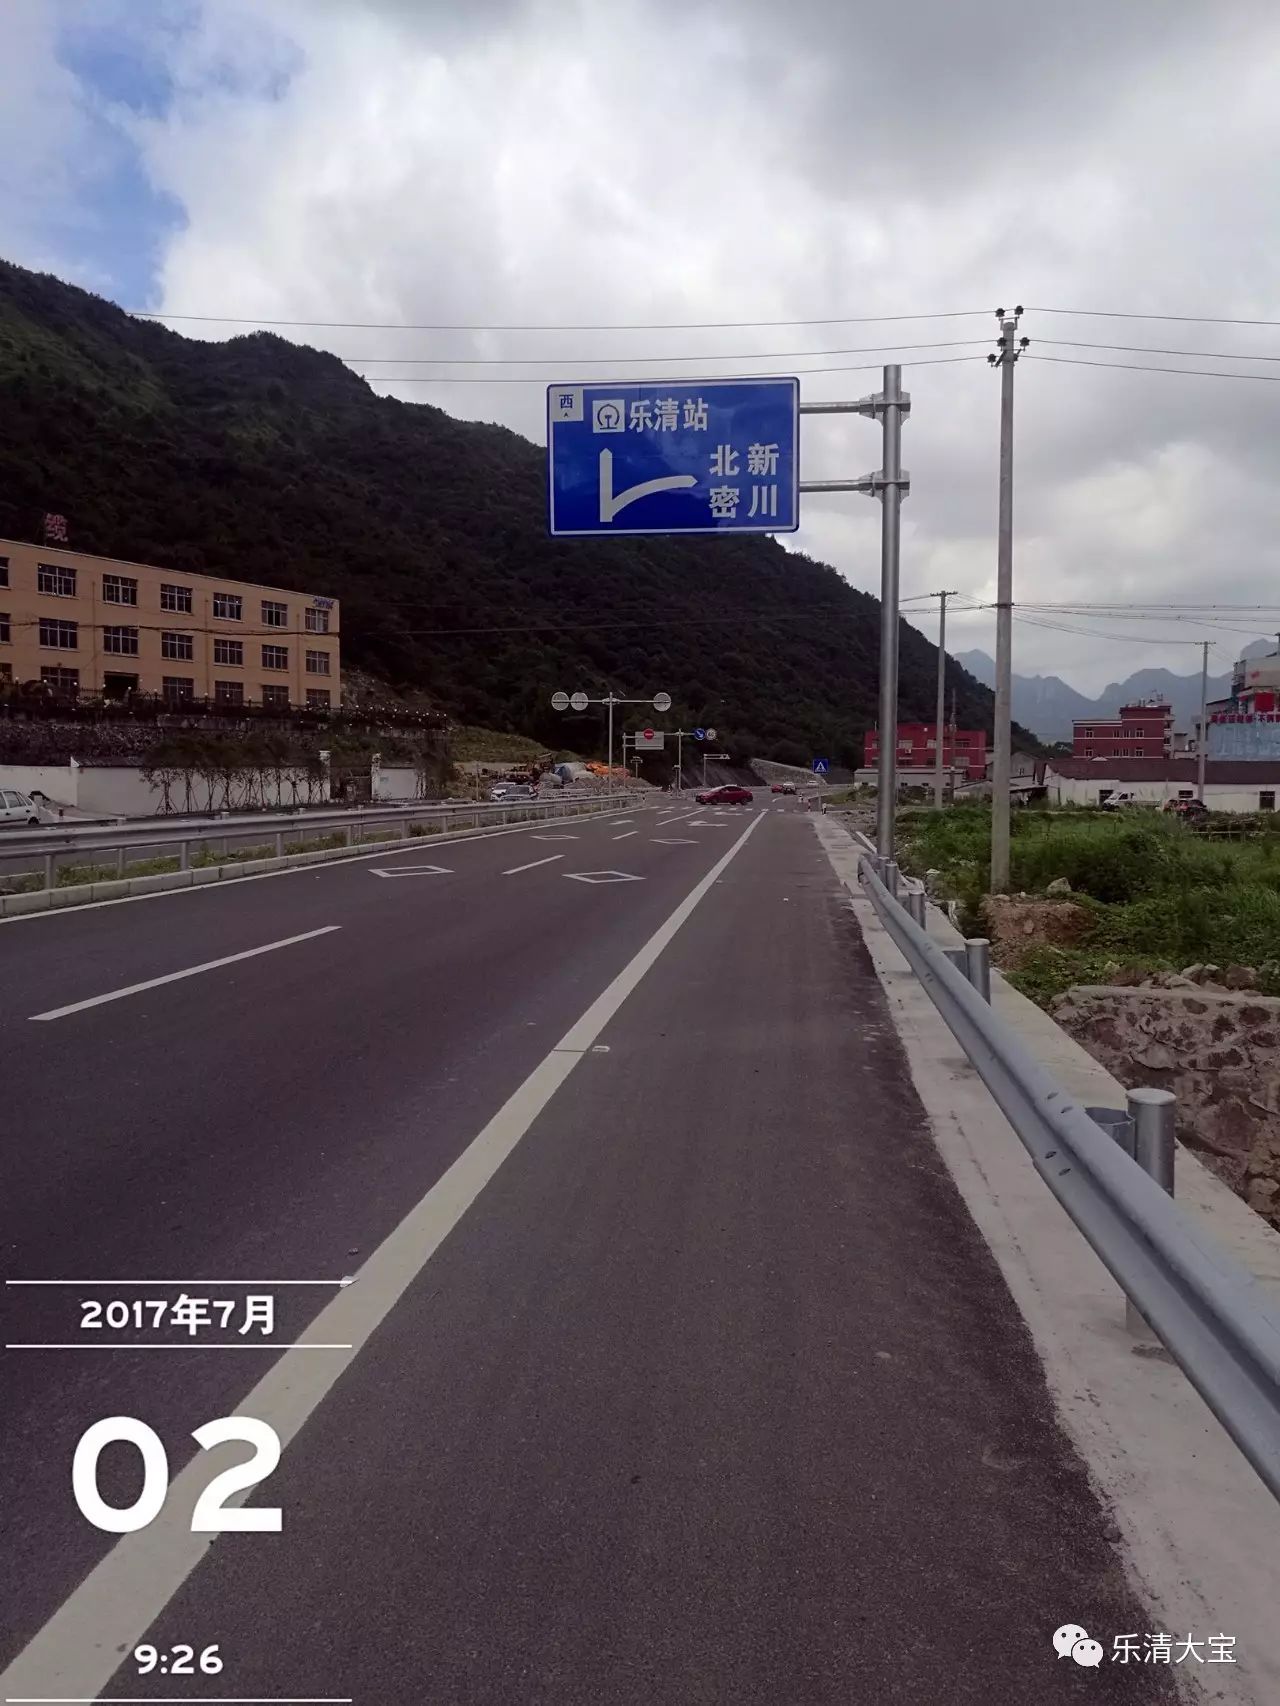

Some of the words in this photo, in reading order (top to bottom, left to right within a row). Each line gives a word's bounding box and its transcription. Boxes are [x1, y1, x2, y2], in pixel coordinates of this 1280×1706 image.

[559, 394, 574, 408] 西
[629, 397, 709, 433] 乐清站
